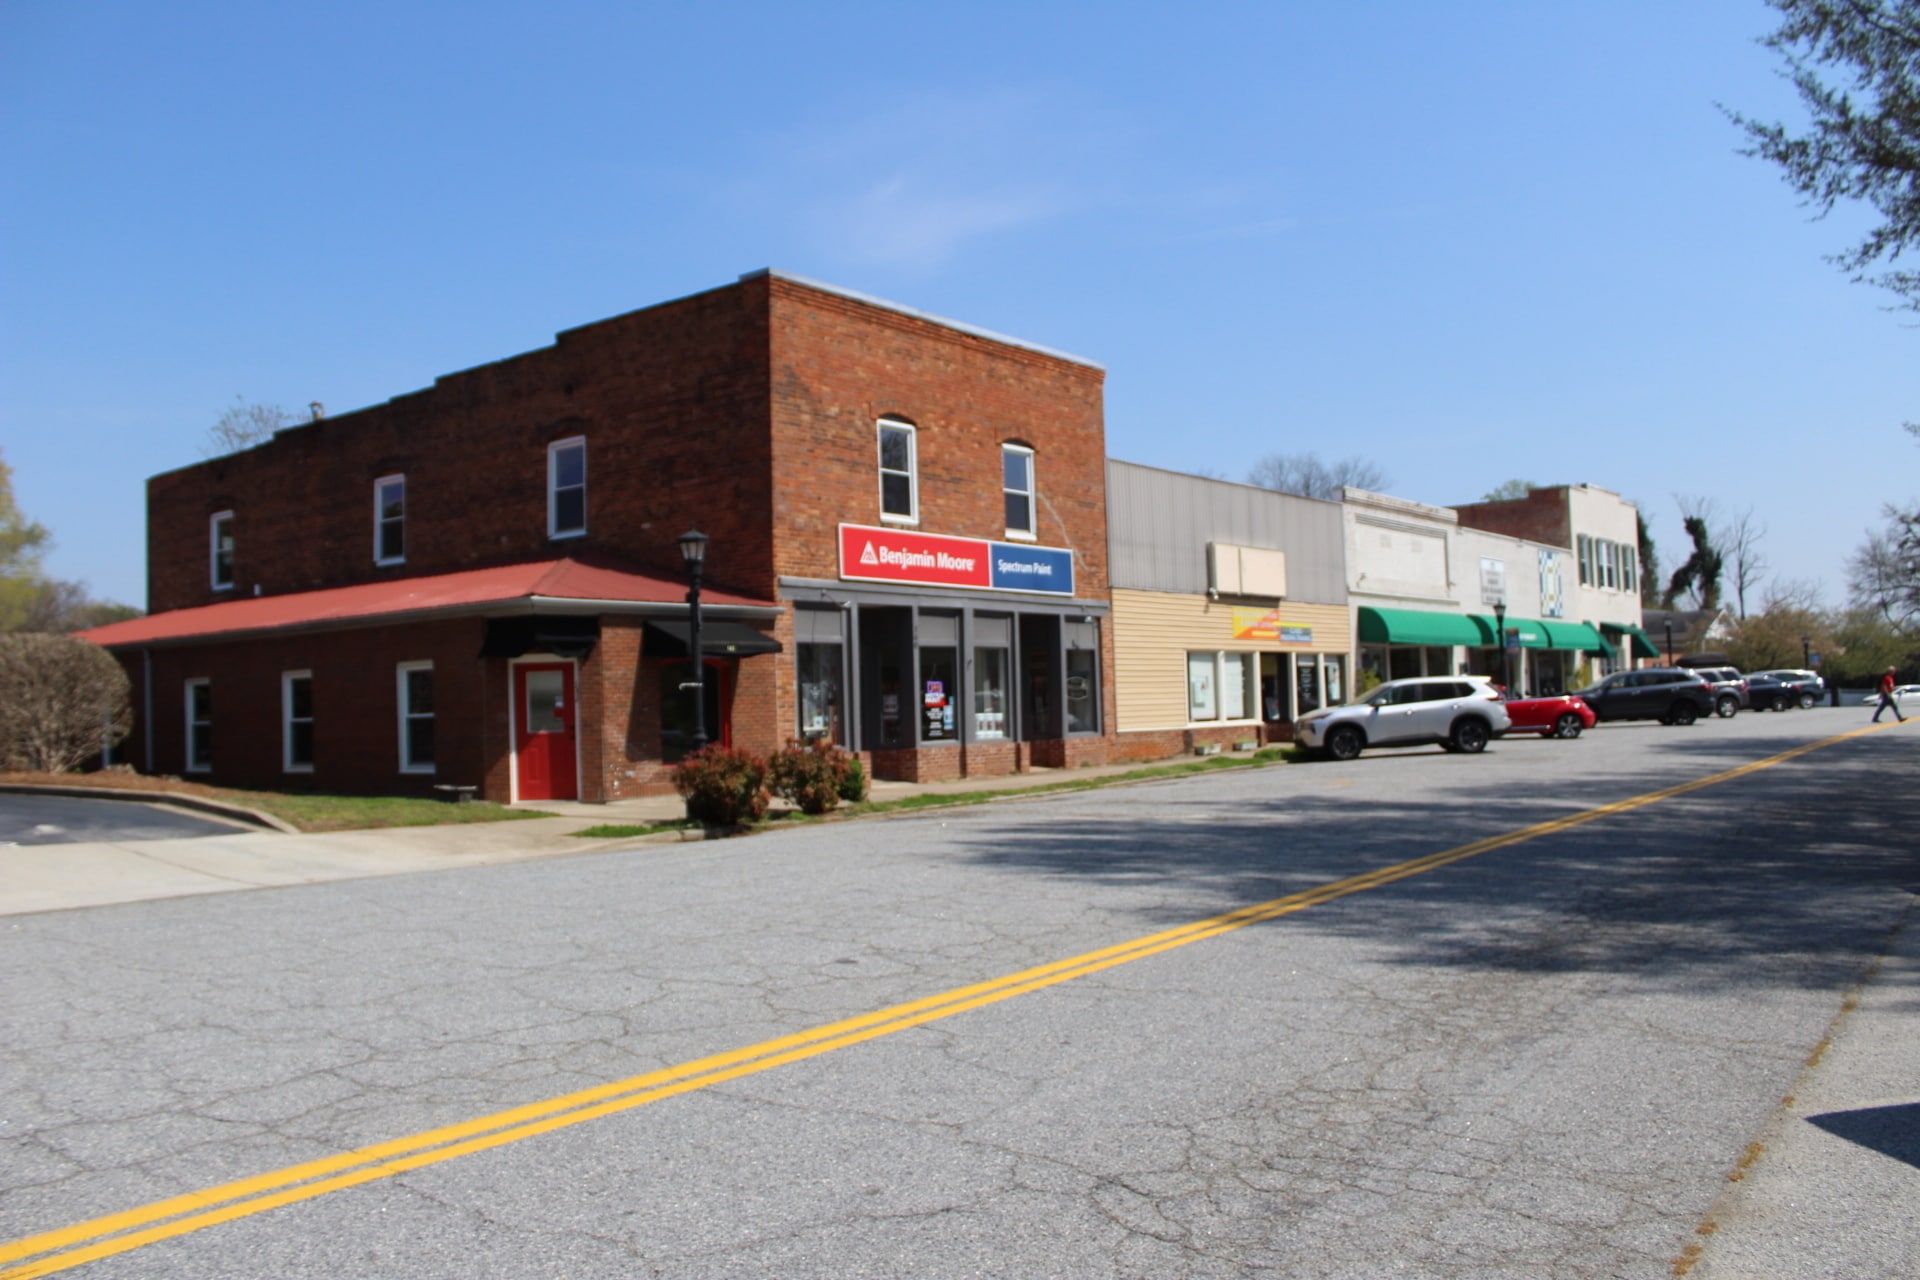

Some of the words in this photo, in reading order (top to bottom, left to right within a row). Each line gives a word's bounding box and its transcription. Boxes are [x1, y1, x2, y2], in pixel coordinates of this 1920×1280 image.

[879, 546, 935, 569] Benjamin
[937, 552, 974, 571] Moore
[998, 559, 1033, 574] Spectrum
[1034, 562, 1051, 575] Paint
